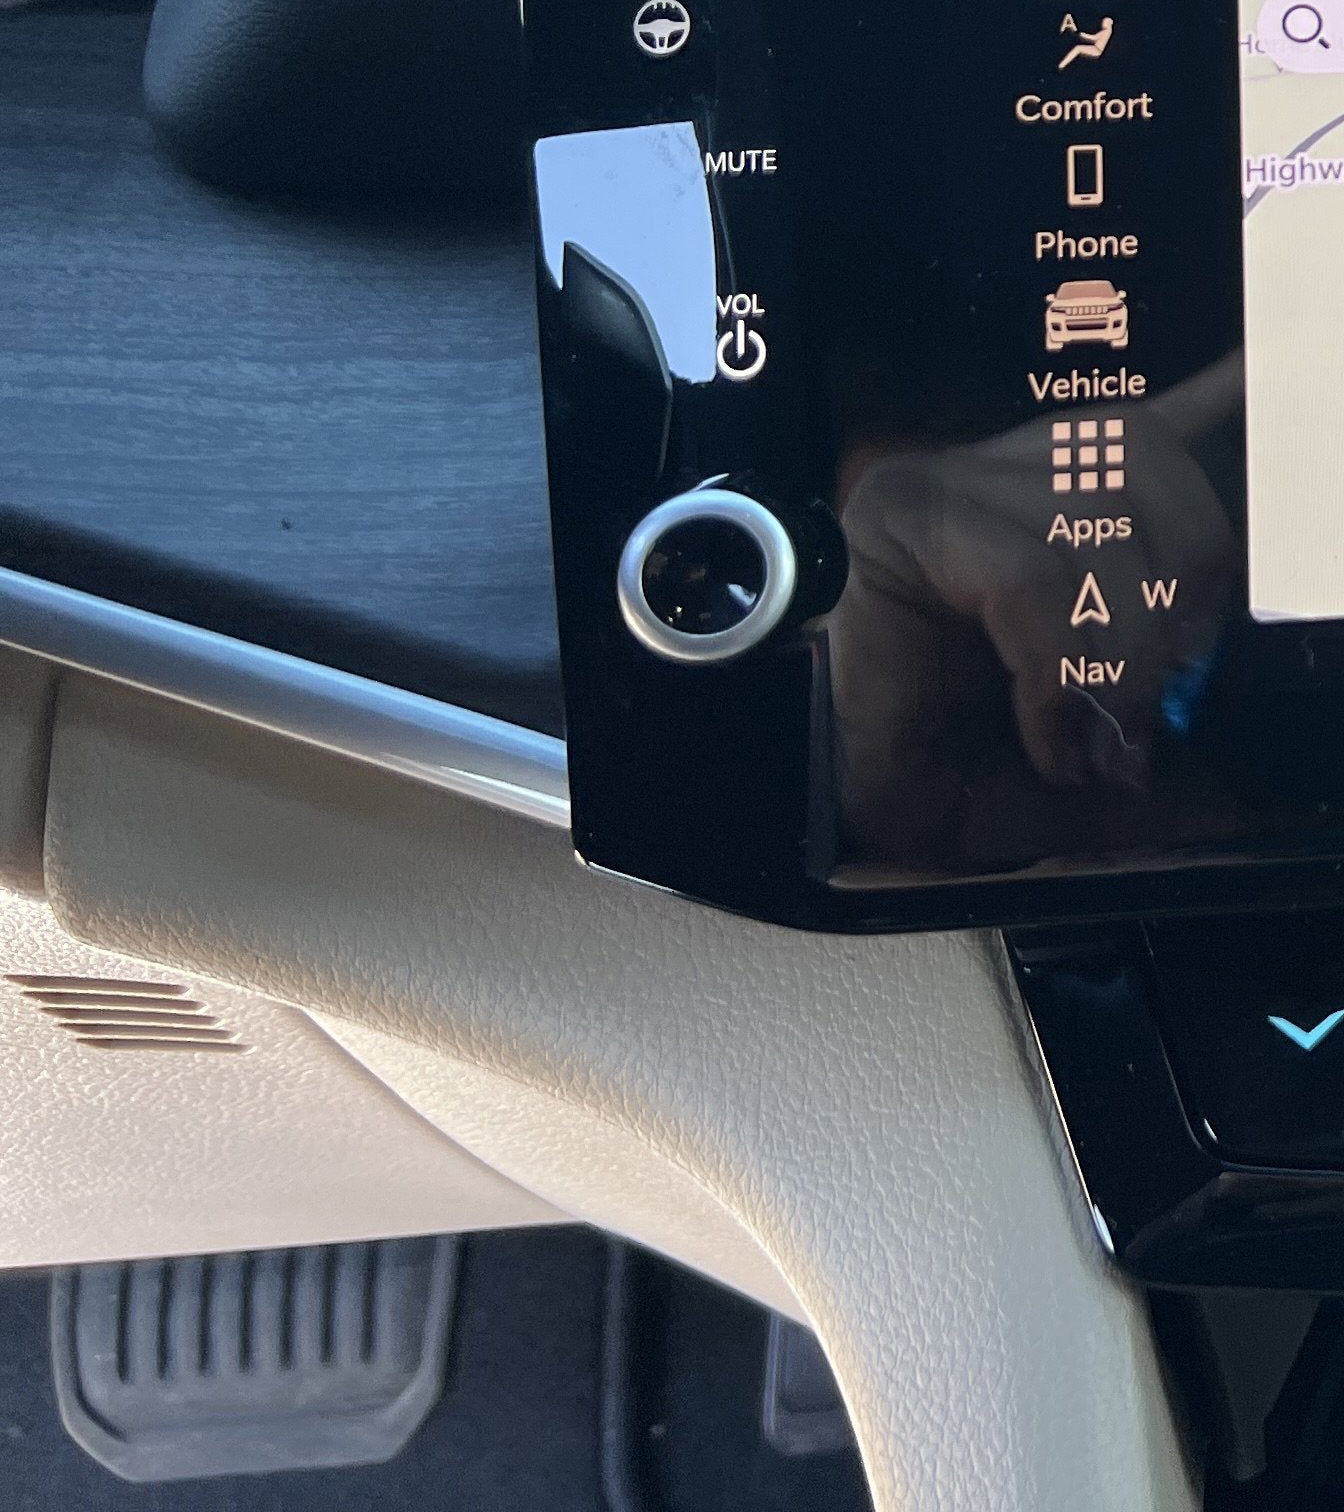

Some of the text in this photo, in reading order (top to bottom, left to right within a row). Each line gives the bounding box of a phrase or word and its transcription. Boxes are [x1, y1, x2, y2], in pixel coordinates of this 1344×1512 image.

[1015, 91, 1154, 123] Comfort
[704, 148, 778, 175] MUTE
[1034, 229, 1140, 260] Phone
[715, 293, 766, 316] VOL
[1027, 367, 1147, 400] Vehicle
[1046, 512, 1134, 548] Apps
[1141, 579, 1179, 611] W
[1059, 657, 1126, 686] Nav
